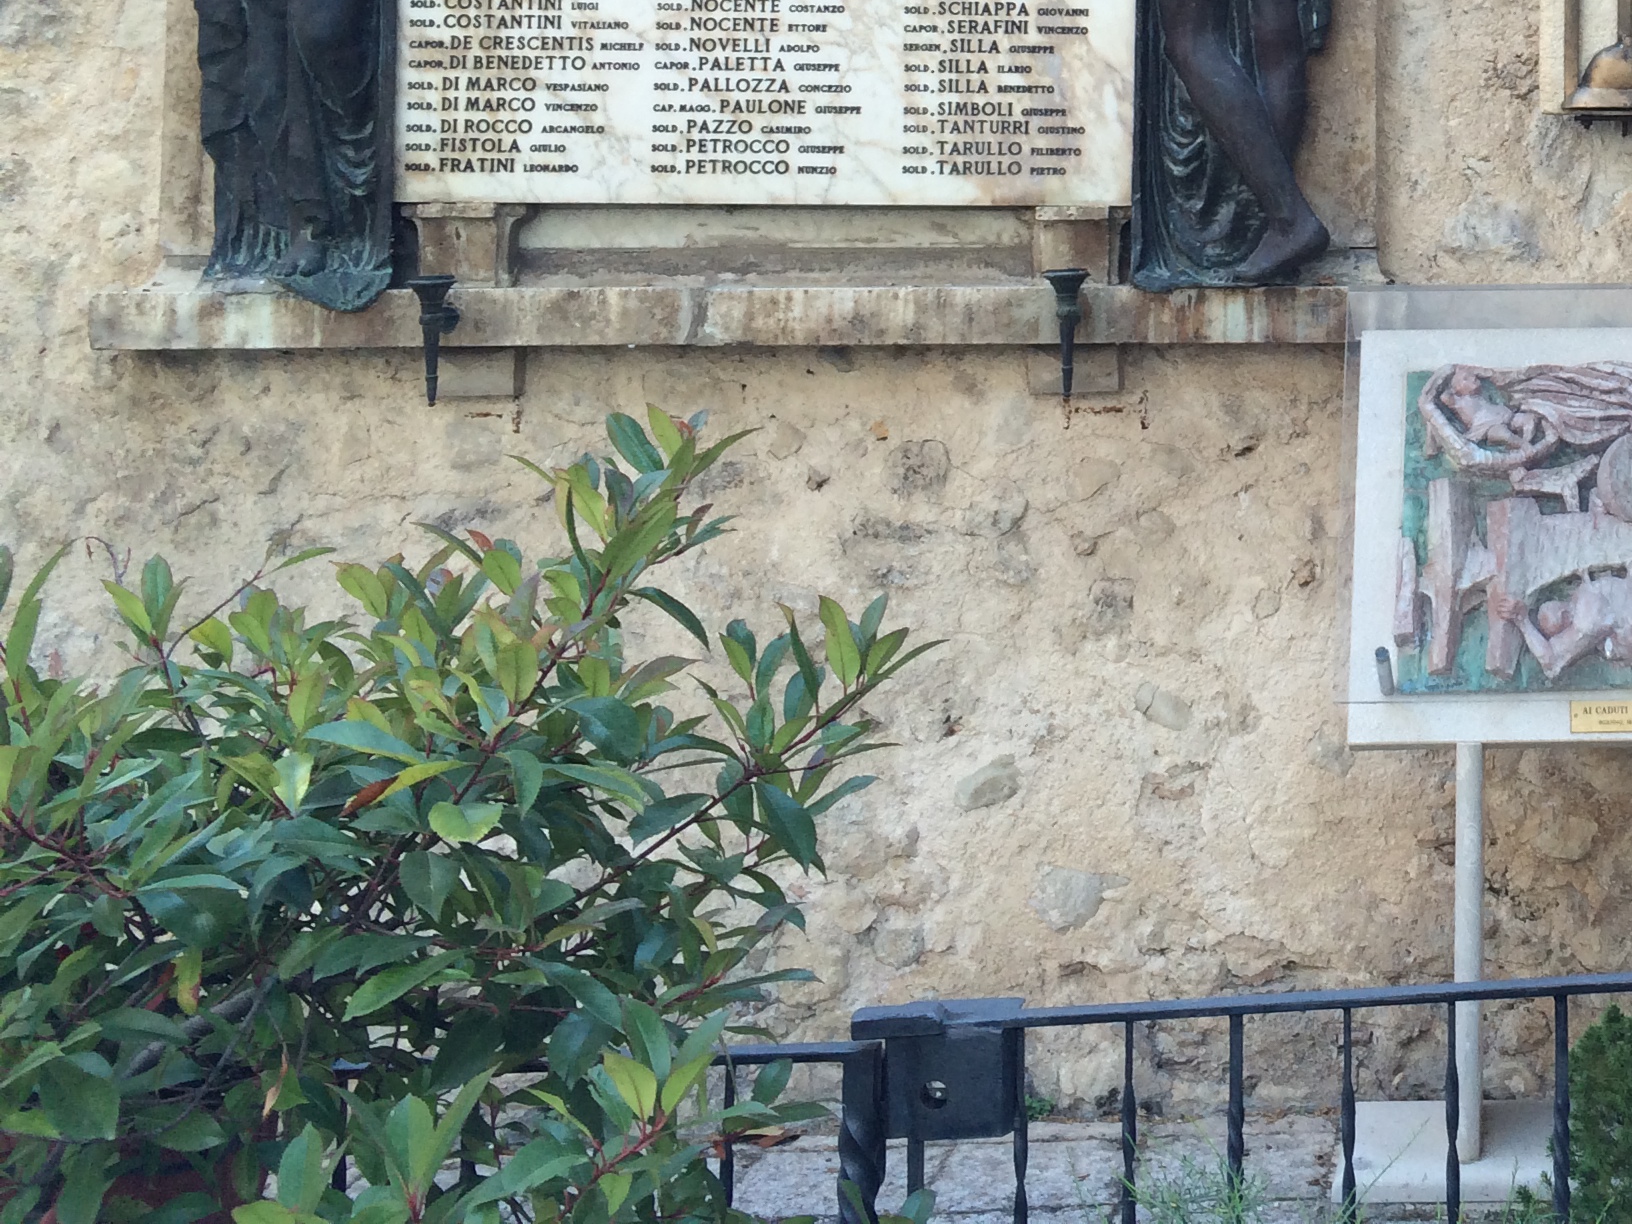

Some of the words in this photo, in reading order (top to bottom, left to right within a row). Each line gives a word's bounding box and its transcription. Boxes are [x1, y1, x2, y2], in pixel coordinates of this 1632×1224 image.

[938, 2, 1029, 16] SCHIAPPA
[1038, 8, 1089, 17] GIOVANNI
[444, 14, 561, 29] COSTANTINI
[571, 21, 629, 30] VITALIANO
[450, 55, 467, 69] DI
[474, 55, 586, 70] BENEDETTO
[591, 62, 640, 70] ANTONIO
[688, 77, 790, 93] PALLOZZA
[798, 85, 852, 93] CONCEZIO
[937, 120, 1029, 135] TANTURRI
[1038, 126, 1085, 135] GIUSTINO
[440, 138, 521, 153] FISTOLA
[530, 144, 566, 153] GIULIO
[1596, 706, 1627, 714] CADUTI
